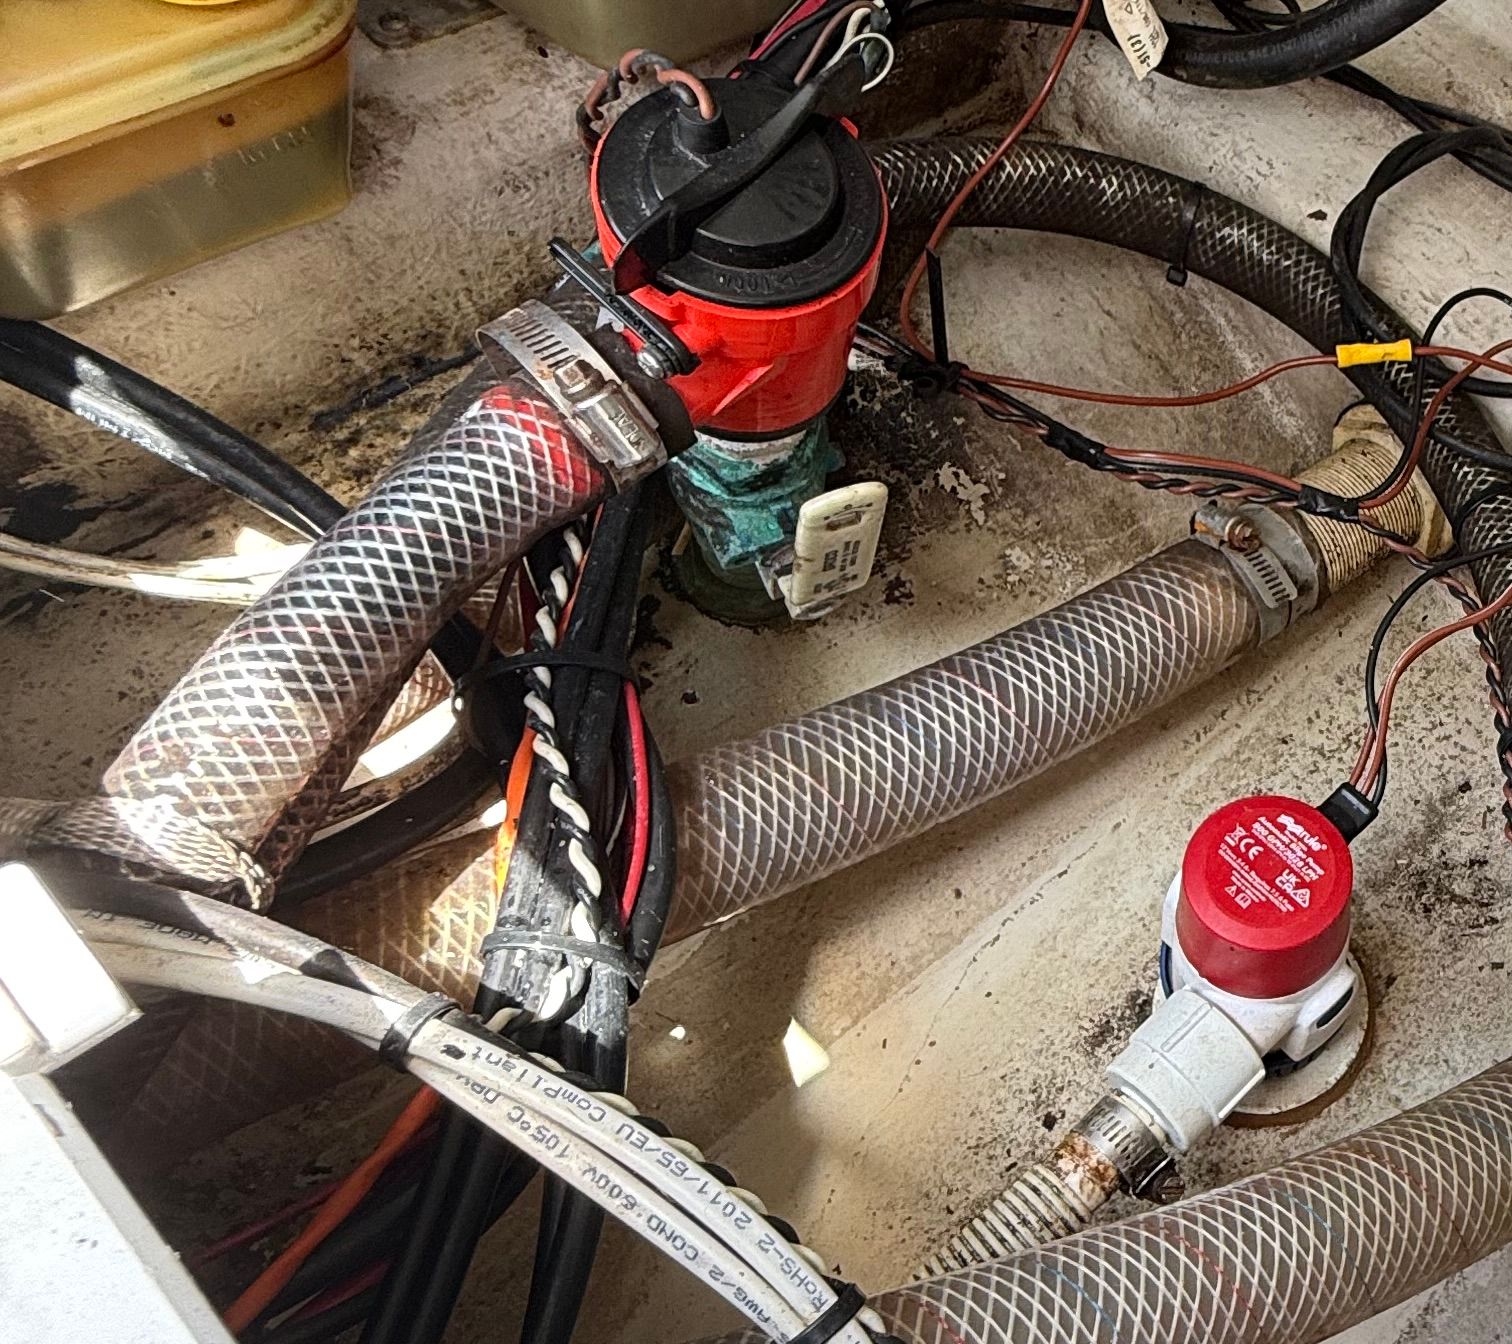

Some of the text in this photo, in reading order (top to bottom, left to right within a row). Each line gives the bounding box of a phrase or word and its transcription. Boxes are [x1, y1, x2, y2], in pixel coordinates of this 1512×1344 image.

[1239, 837, 1264, 861] CE
[1304, 855, 1326, 876] Pump
[1281, 868, 1301, 887] UK
[579, 1161, 639, 1213] 600V
[614, 1119, 753, 1230] 2011/65/EU
[643, 1211, 701, 1262] COND
[704, 1262, 774, 1325] AWG/2
[754, 1230, 831, 1313] RoHS-2
